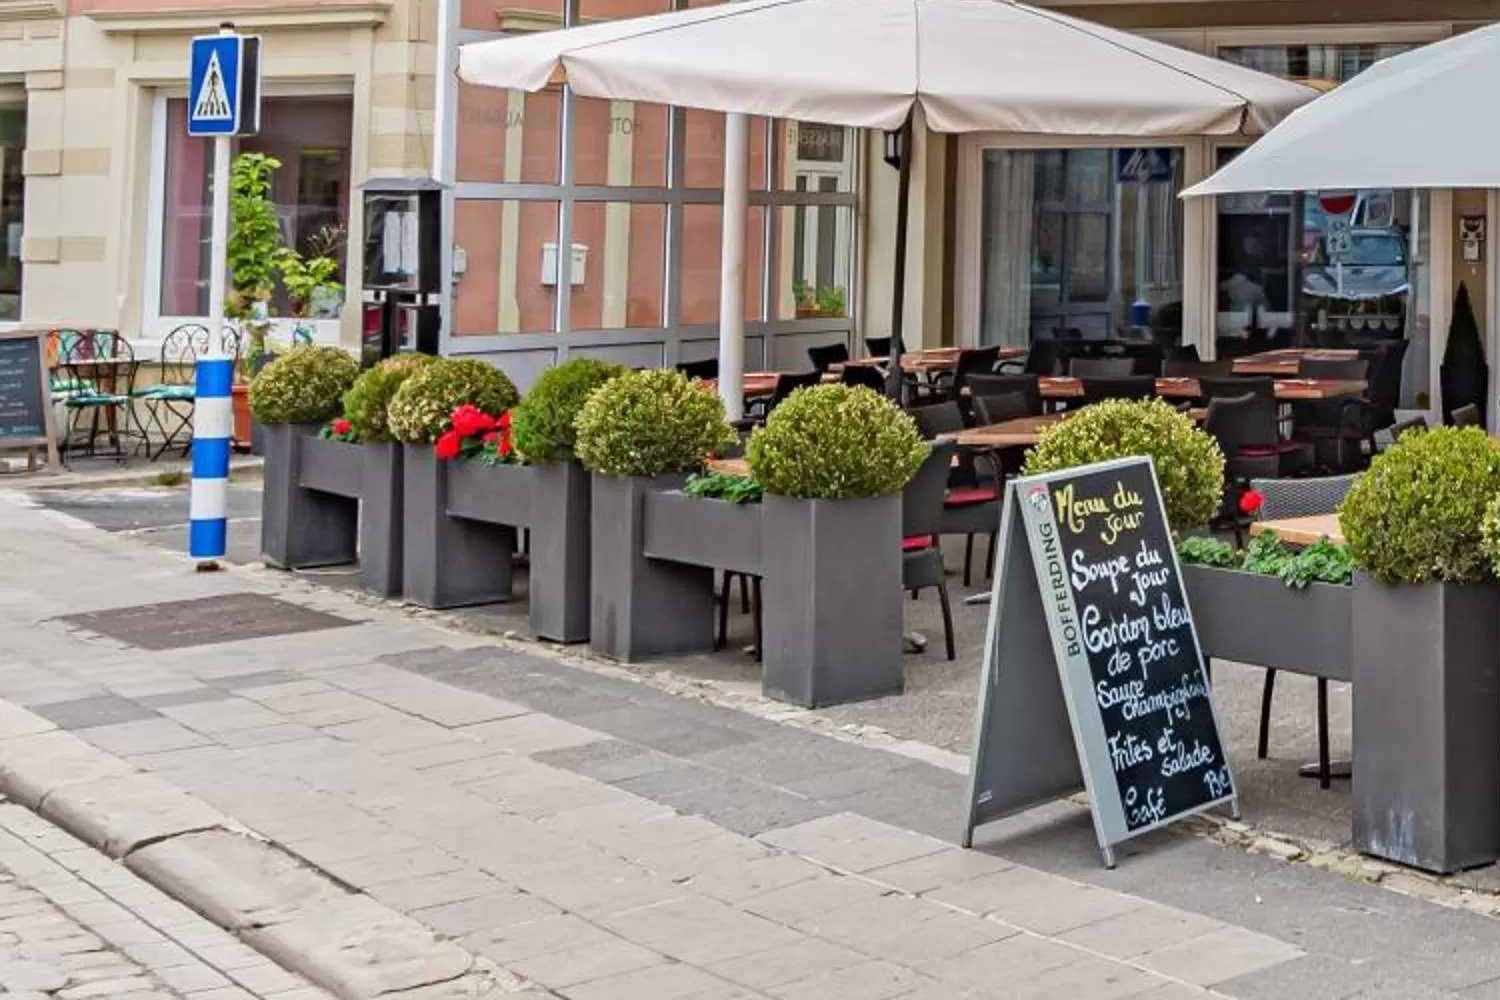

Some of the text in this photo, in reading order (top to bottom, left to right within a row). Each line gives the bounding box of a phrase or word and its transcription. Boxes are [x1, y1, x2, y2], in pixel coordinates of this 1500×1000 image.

[1113, 480, 1143, 508] du
[1071, 539, 1163, 595] Soupe du
[1039, 523, 1081, 657] BOFFERDING
[1152, 592, 1192, 631] bleu
[1107, 638, 1180, 680] de porc
[1157, 727, 1177, 754] et
